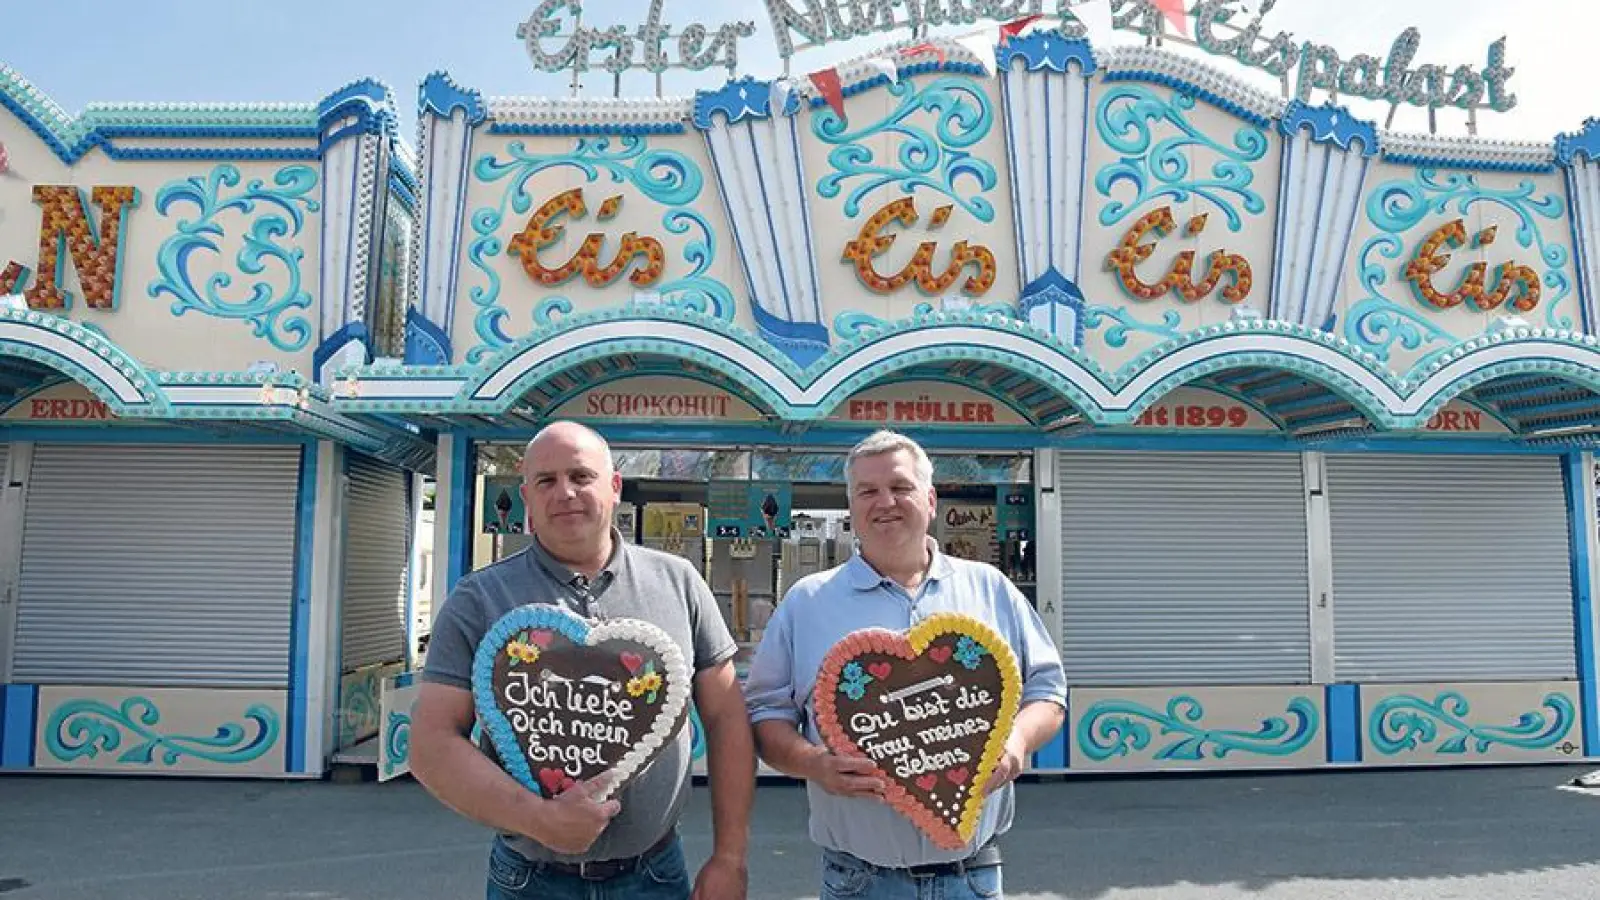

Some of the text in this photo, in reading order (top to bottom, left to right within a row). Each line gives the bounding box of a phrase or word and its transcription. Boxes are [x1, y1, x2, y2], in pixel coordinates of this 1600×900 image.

[516, 0, 756, 73] Erster
[1190, 0, 1516, 112] Eispalast
[506, 187, 666, 288] Eis
[840, 196, 997, 297] Eis
[1103, 206, 1253, 304] Eis
[1404, 219, 1541, 312] Eis
[586, 392, 731, 417] SCHOKOHUT
[849, 396, 995, 423] EIS MÜLLER
[1134, 405, 1249, 428] it 1899
[505, 671, 634, 720] Ich liebe
[850, 684, 994, 734] Du bist die
[506, 707, 631, 748] Dich mein
[857, 716, 991, 760] Frau meines
[527, 734, 608, 776] Engel
[893, 746, 971, 779] Lebens
